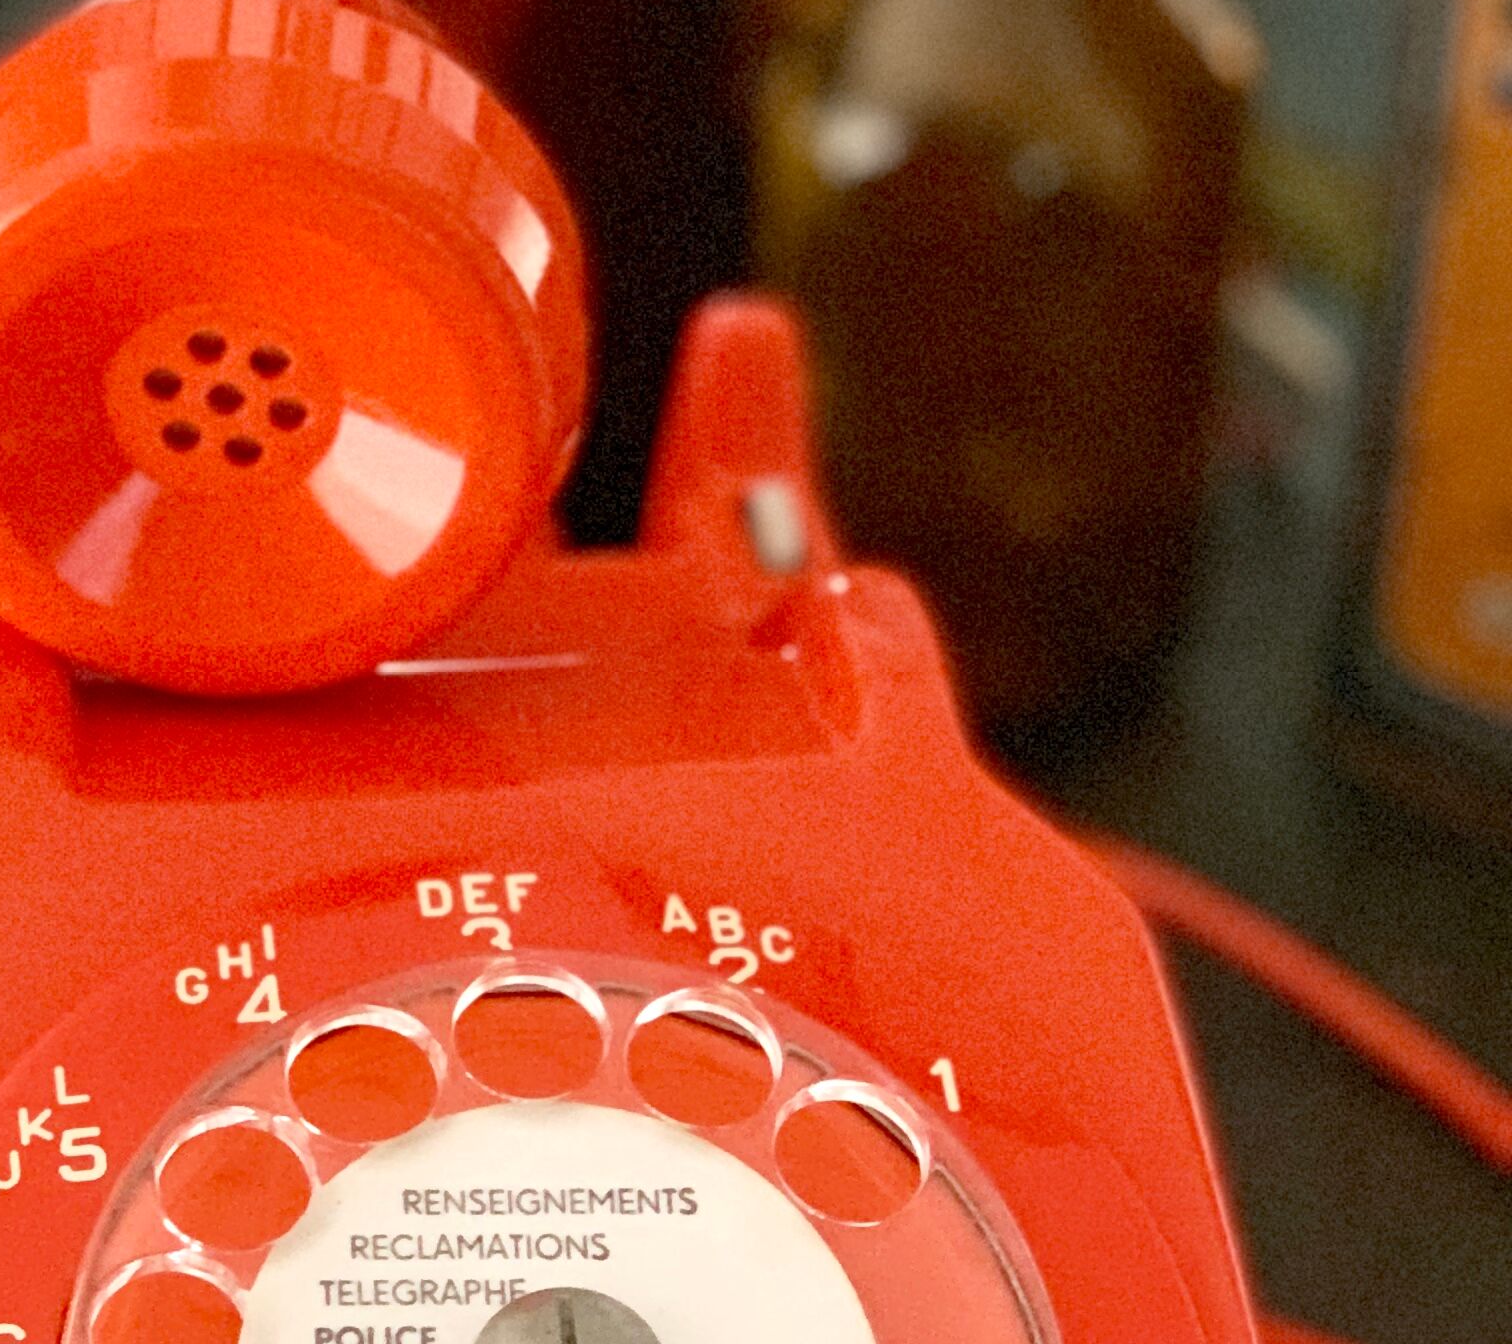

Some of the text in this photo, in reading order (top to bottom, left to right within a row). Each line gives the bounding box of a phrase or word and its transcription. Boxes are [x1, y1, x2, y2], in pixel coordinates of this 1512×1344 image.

[416, 872, 538, 918] DEF
[236, 966, 288, 1025] 4
[929, 1057, 961, 1113] 1
[57, 1126, 109, 1183] 5
[401, 1185, 699, 1219] RENSEIGNEMENTS
[349, 1231, 611, 1263] RECLAMATIONS
[318, 1277, 527, 1306] TELEGRAPHE
